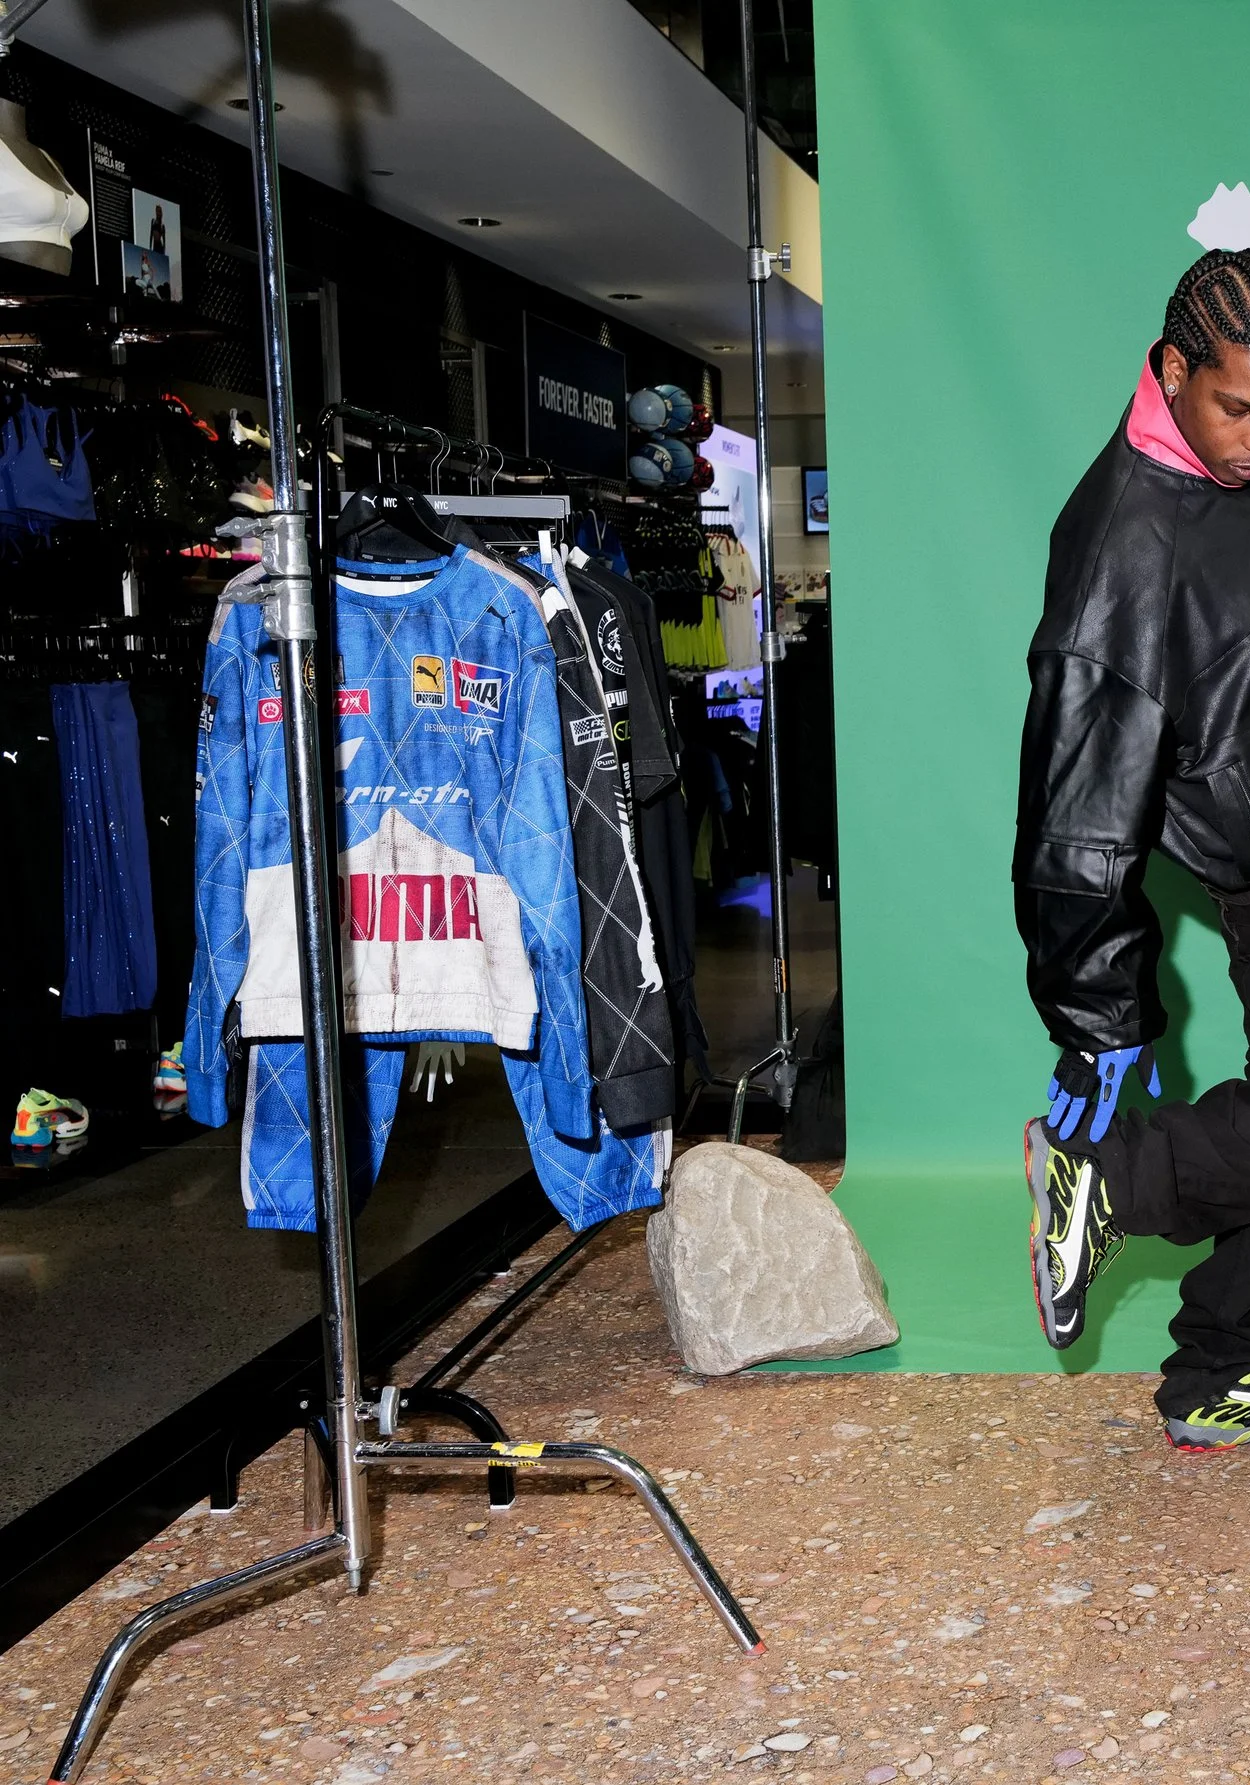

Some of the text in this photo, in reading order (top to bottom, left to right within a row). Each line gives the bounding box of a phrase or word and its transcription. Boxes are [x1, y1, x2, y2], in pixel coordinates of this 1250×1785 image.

[539, 375, 617, 430] FOREVER. FASTER.
[383, 497, 398, 508] NYC
[434, 501, 449, 510] NYC
[460, 679, 499, 709] UMA
[339, 873, 484, 942] UMA
